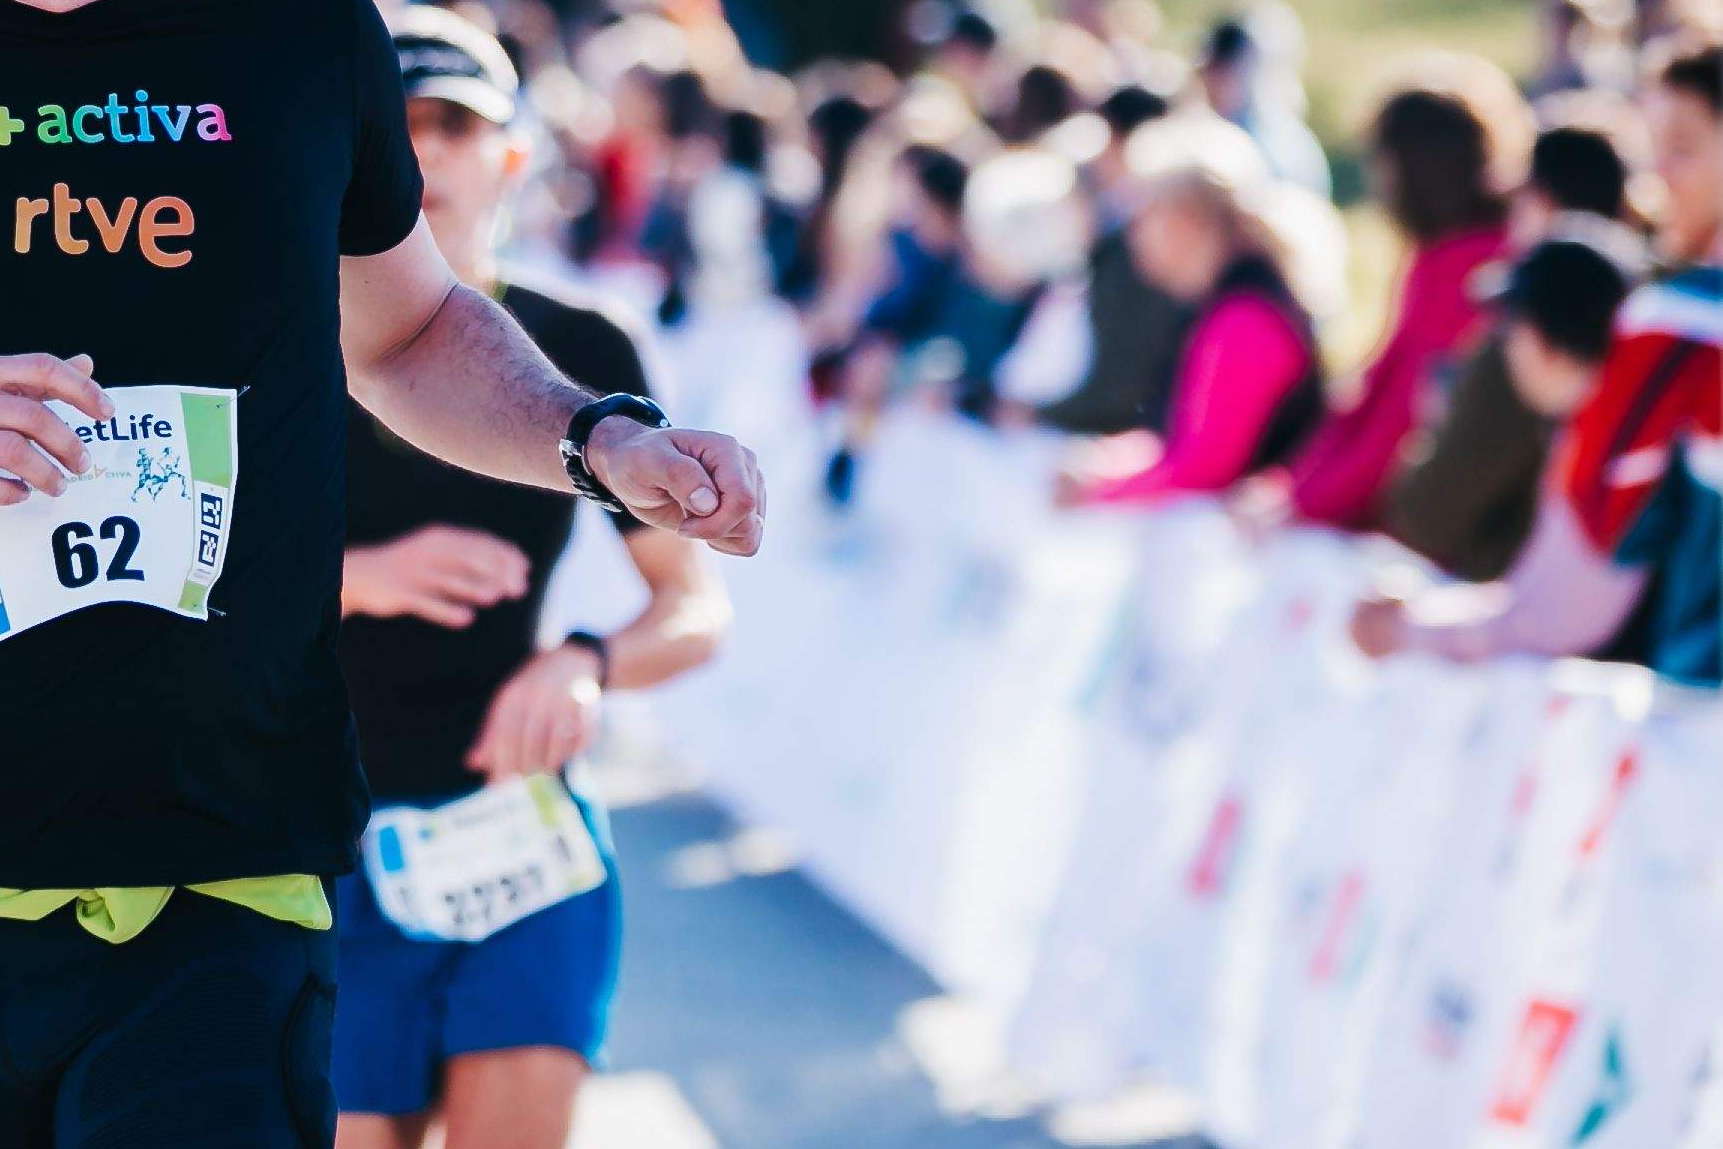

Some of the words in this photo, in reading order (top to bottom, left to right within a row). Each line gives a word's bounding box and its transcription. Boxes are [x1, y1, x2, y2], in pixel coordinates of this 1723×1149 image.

[38, 89, 232, 143] activa
[14, 182, 194, 267] rtve
[66, 413, 172, 443] etLife
[52, 516, 145, 588] 62
